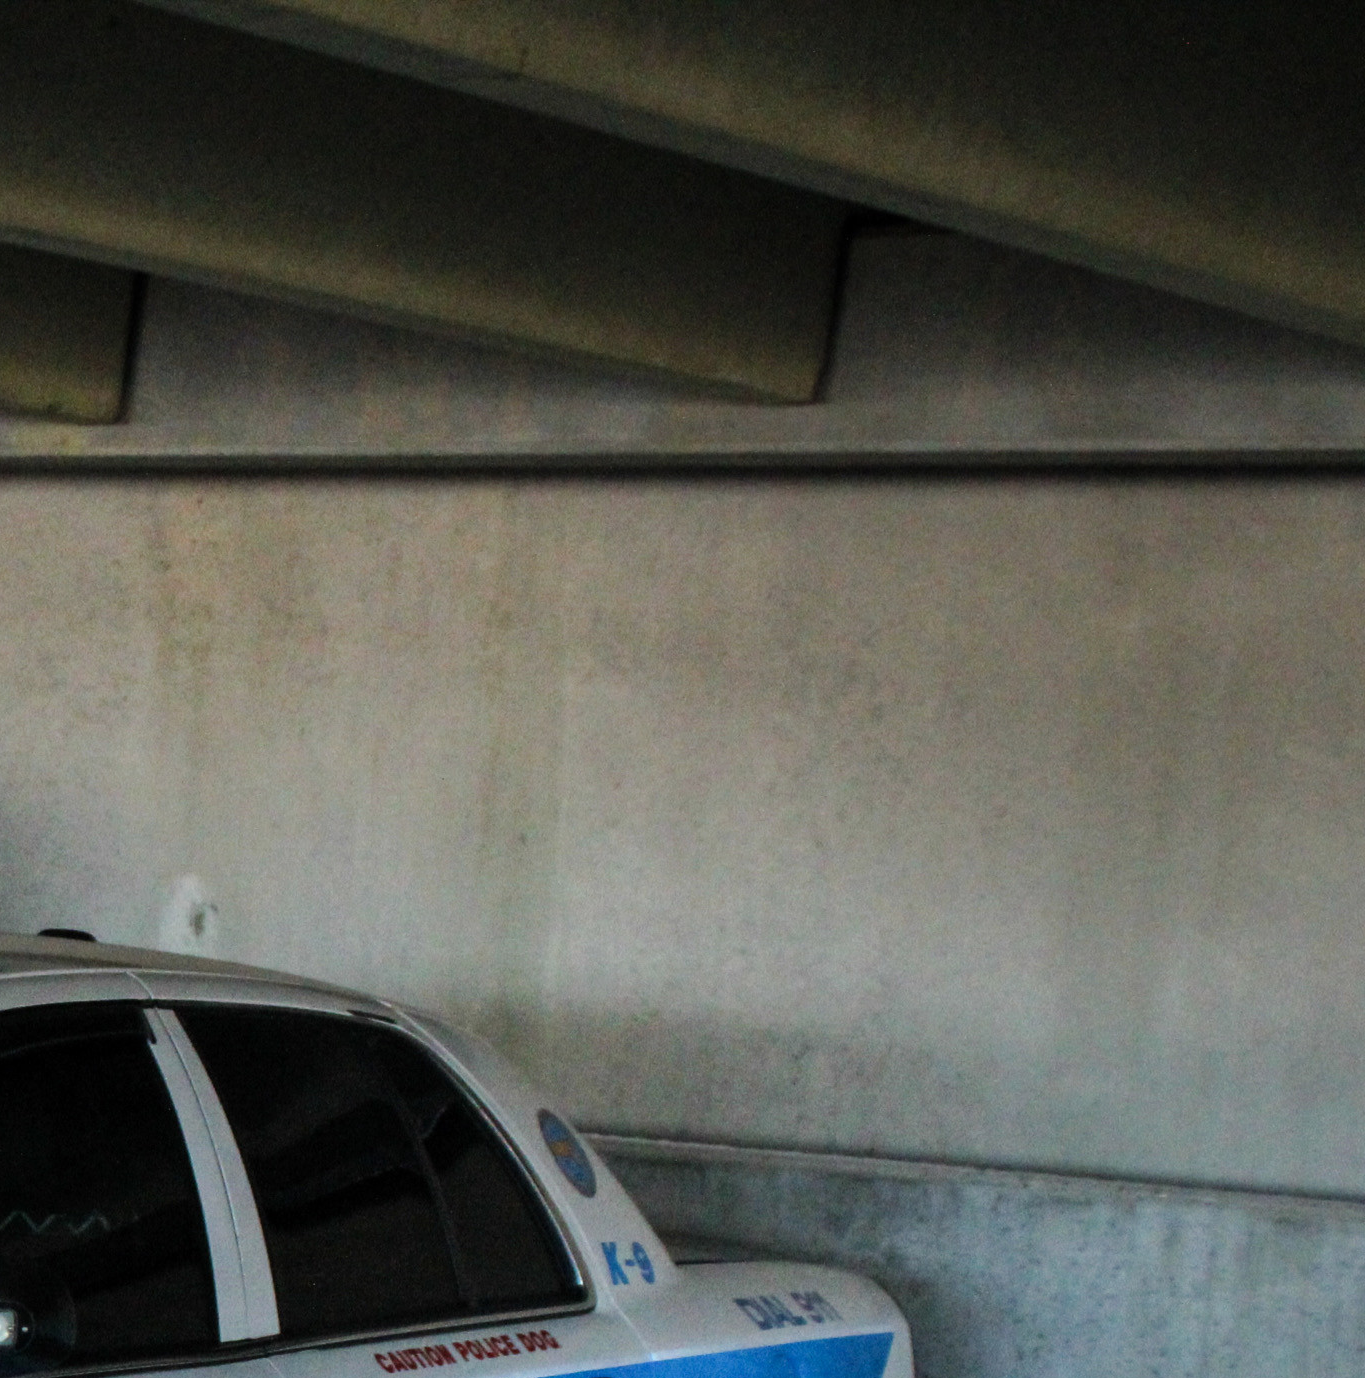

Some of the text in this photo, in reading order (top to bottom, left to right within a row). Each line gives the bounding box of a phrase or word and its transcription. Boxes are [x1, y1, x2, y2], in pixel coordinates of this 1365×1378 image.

[601, 1241, 655, 1286] K-9
[374, 1329, 561, 1374] CAUTION POLICE DOG
